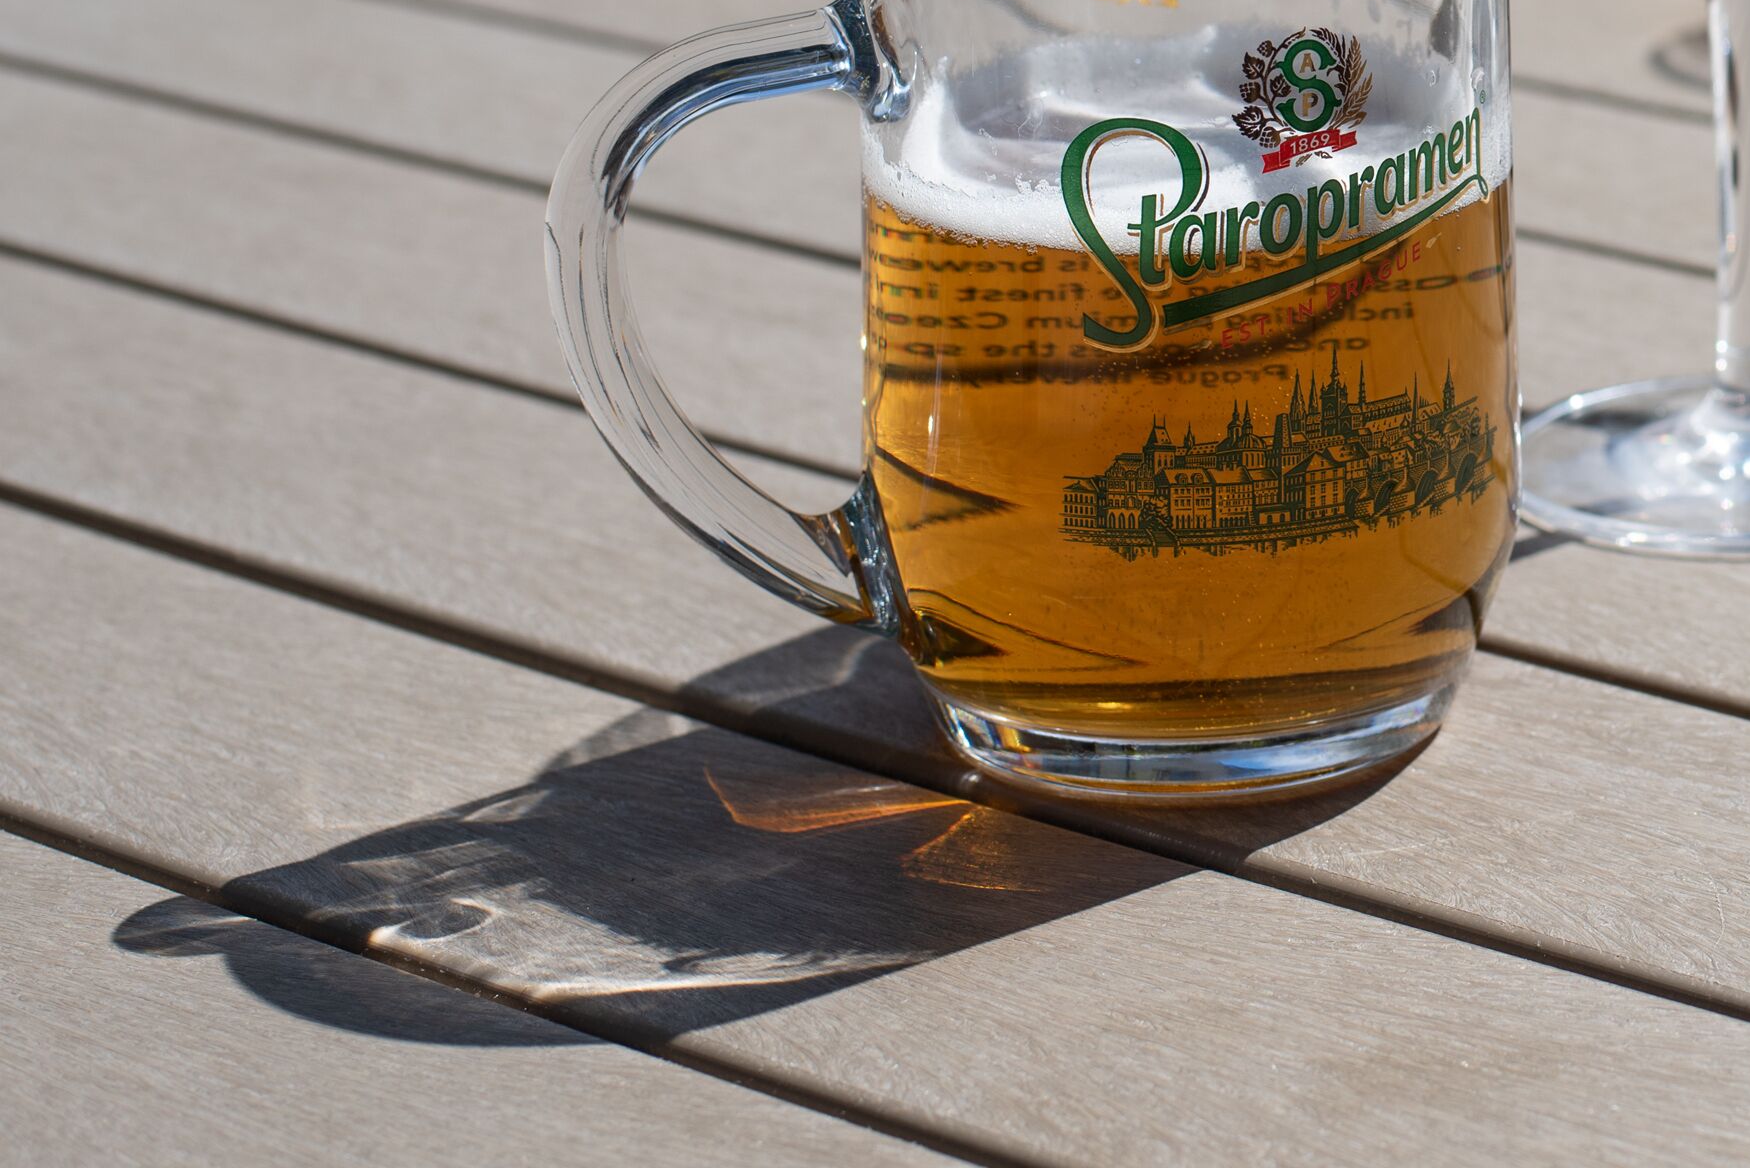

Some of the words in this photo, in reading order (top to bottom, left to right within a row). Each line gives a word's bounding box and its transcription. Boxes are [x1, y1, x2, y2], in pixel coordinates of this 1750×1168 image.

[1289, 133, 1330, 155] 1869
[1060, 106, 1489, 353] Staropramen
[1286, 298, 1314, 329] IN
[1326, 240, 1421, 312] PRAGUE
